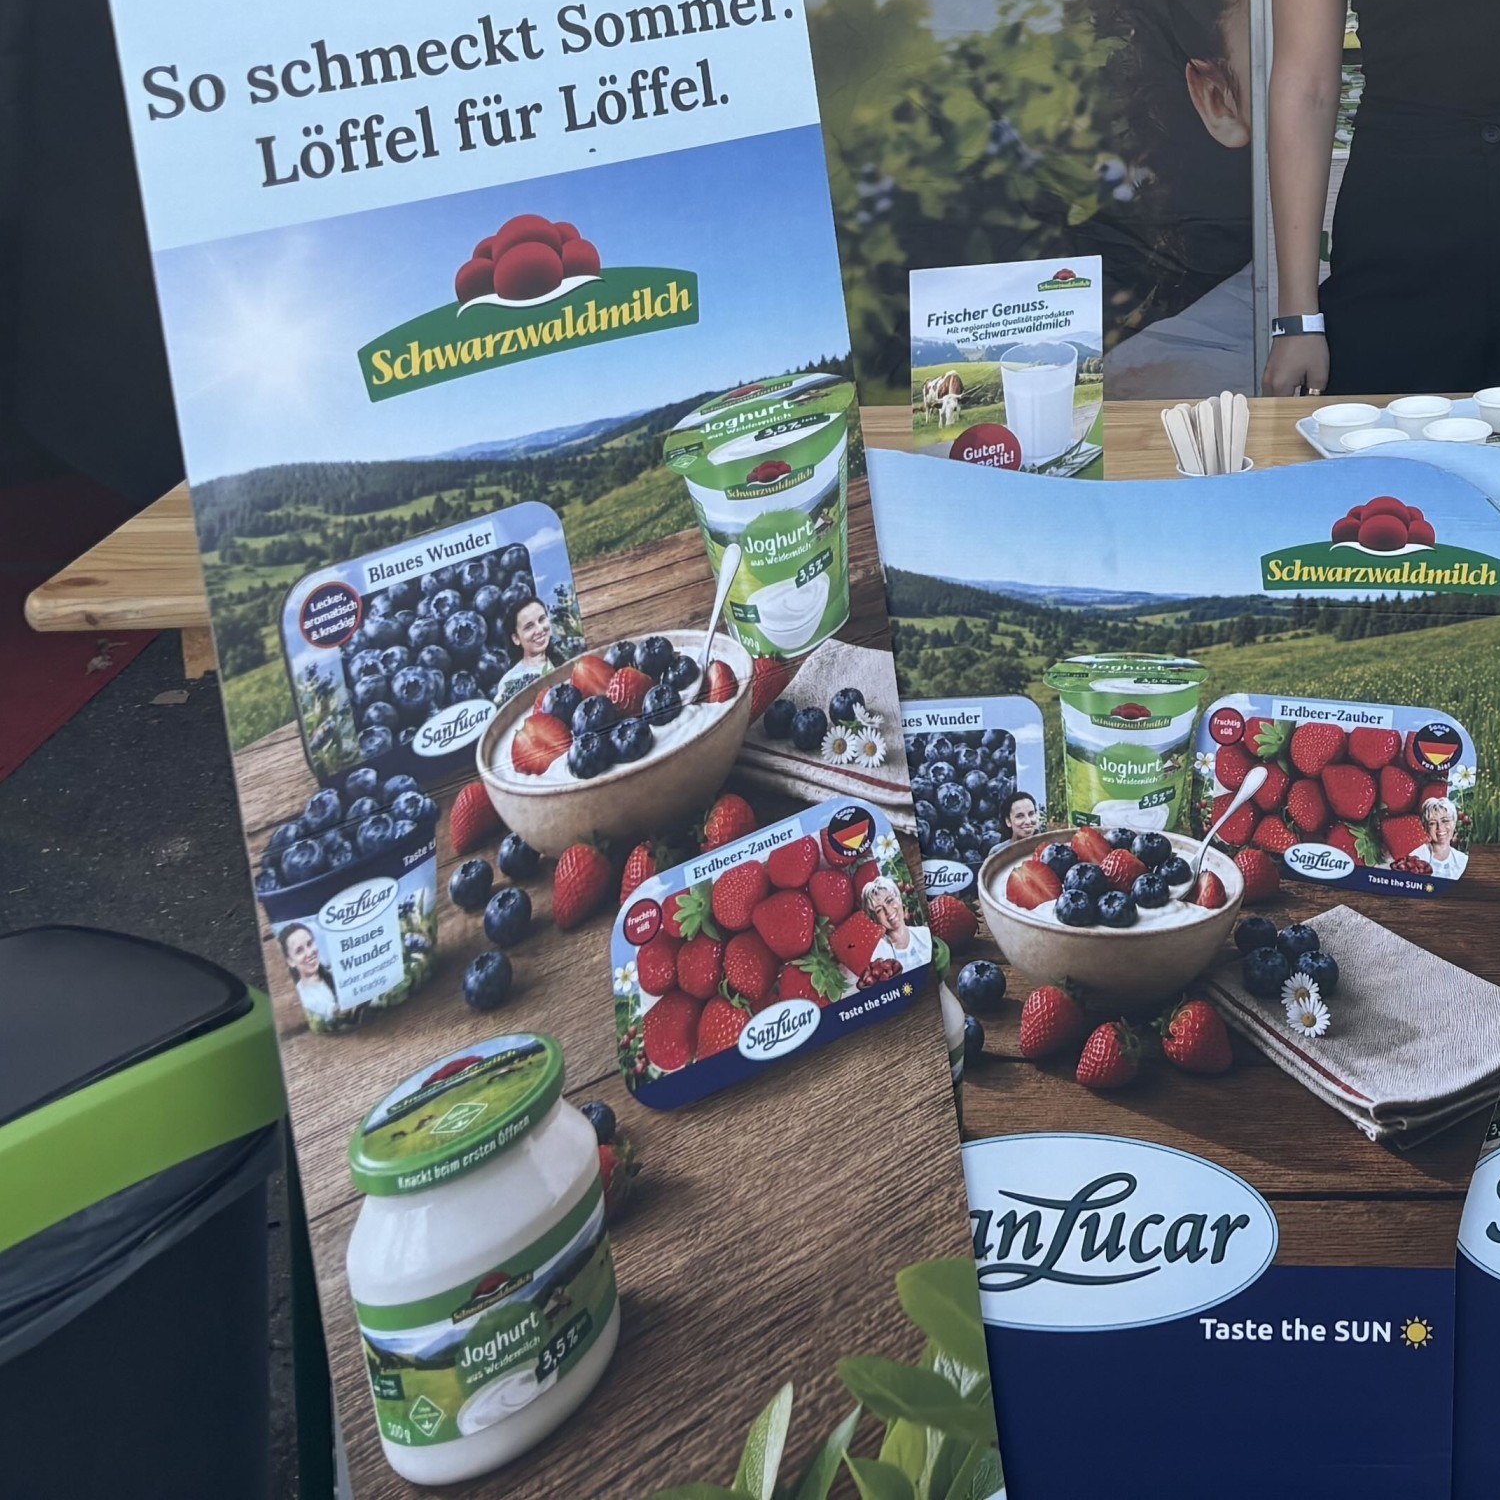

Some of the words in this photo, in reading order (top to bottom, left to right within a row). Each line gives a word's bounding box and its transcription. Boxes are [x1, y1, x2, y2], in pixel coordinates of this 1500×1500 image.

[142, 64, 227, 122] So
[248, 15, 544, 106] schmeckt
[256, 107, 439, 188] Löffel
[455, 94, 544, 150] für
[562, 58, 730, 134] Löffel.
[927, 308, 988, 328] Frischer
[992, 300, 1049, 317] Genuss.
[947, 325, 959, 335] Mit
[961, 319, 1000, 334] regionalen
[1002, 308, 1074, 327] Qualitätsprodukten
[371, 280, 692, 386] Schwarzwaldmilch
[957, 336, 970, 344] von
[972, 317, 1071, 342] Schwarzwaldmilch
[700, 401, 794, 434] Joghurt
[963, 443, 1005, 460] Guten
[727, 469, 813, 498] Schwarzwaldmilch
[744, 520, 814, 556] Joghurt
[368, 554, 423, 584] Blaues
[426, 530, 492, 563] Wunder
[799, 560, 823, 582] 3,5%
[1267, 559, 1498, 586] Schwarzwaldmilch
[303, 601, 358, 630] aromatisch
[421, 706, 492, 749] SanLucar
[925, 712, 981, 726] Wunder
[1214, 718, 1241, 729] fruchtig
[1281, 705, 1383, 725] Erdbeer-Zauber
[1099, 757, 1161, 777] Joghurt
[1143, 792, 1165, 806] 3,5%
[403, 847, 421, 867] Taste
[694, 828, 794, 879] Erdbeer-Zauber
[1290, 849, 1349, 871] SanLucar
[1368, 875, 1389, 886] Taste
[1391, 878, 1404, 888] the
[1405, 880, 1423, 890] SUN
[325, 885, 394, 925] SanLucar
[627, 909, 657, 927] fruchtig
[340, 926, 384, 952] Blaues
[340, 940, 393, 971] Wunder
[838, 1006, 863, 1023] Taste
[864, 999, 880, 1015] the
[880, 988, 901, 1005] SUN
[746, 1008, 814, 1050] SanLucar
[434, 1159, 460, 1179] beim
[463, 1140, 497, 1166] ersten
[498, 1115, 530, 1146] Öffnen
[461, 1311, 539, 1367] Joghurt
[1199, 1318, 1273, 1340] Taste
[1281, 1318, 1326, 1341] the
[1334, 1320, 1391, 1342] SUN
